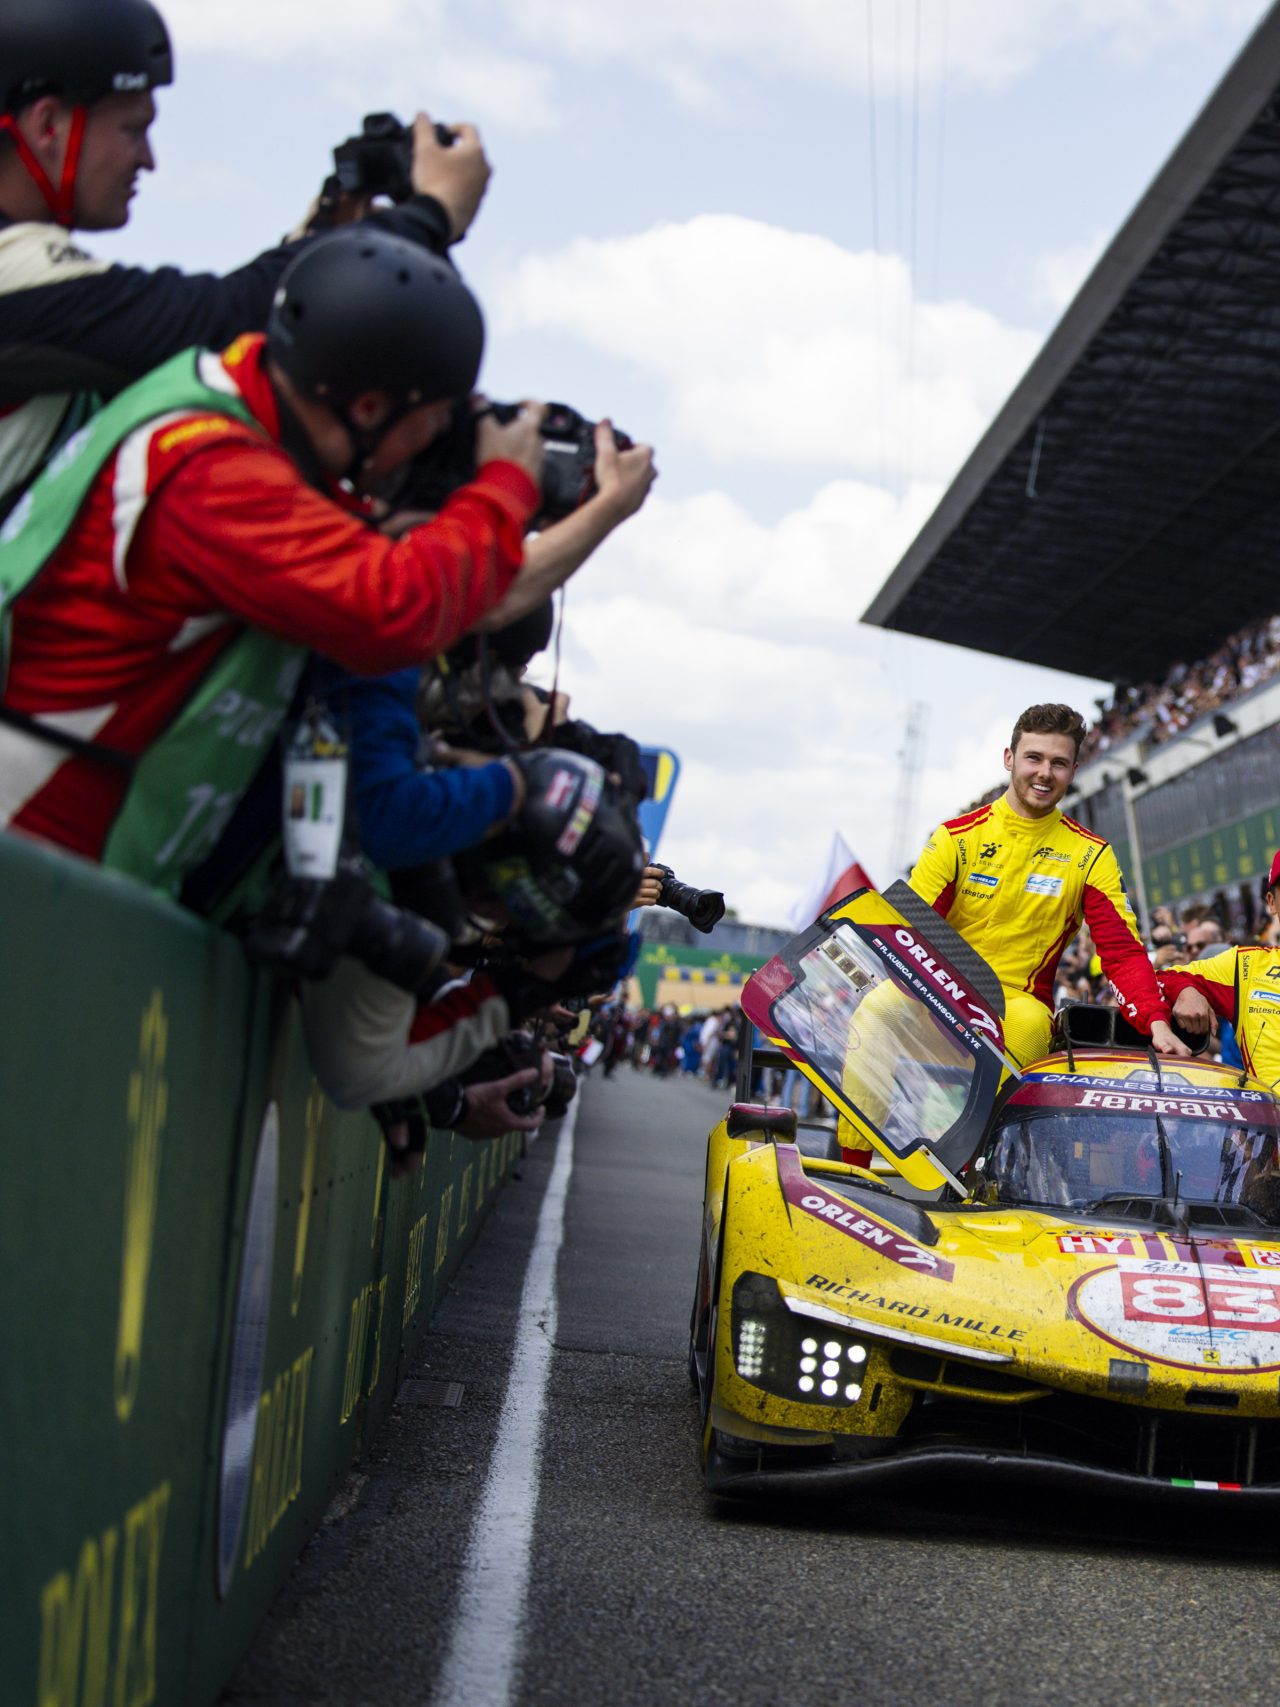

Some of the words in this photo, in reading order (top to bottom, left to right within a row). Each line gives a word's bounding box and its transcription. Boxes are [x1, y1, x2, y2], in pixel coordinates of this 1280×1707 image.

[1077, 845, 1096, 871] Sabelt
[1027, 876, 1062, 889] WEC
[895, 929, 967, 1001] ORLEN
[880, 944, 888, 955] R.
[887, 951, 913, 980] KUBICA
[920, 986, 928, 995] P.
[926, 992, 958, 1024] HANSON
[964, 1030, 972, 1039] Y.
[970, 1037, 982, 1050] YE
[1042, 1074, 1155, 1091] CHARLES
[1161, 1085, 1233, 1098] POZZI
[1075, 1089, 1248, 1121] Ferrari
[801, 1195, 893, 1246] ORLEN
[1060, 1237, 1125, 1254] HY
[805, 1273, 932, 1319] RICHARD
[935, 1312, 1028, 1342] MILLE
